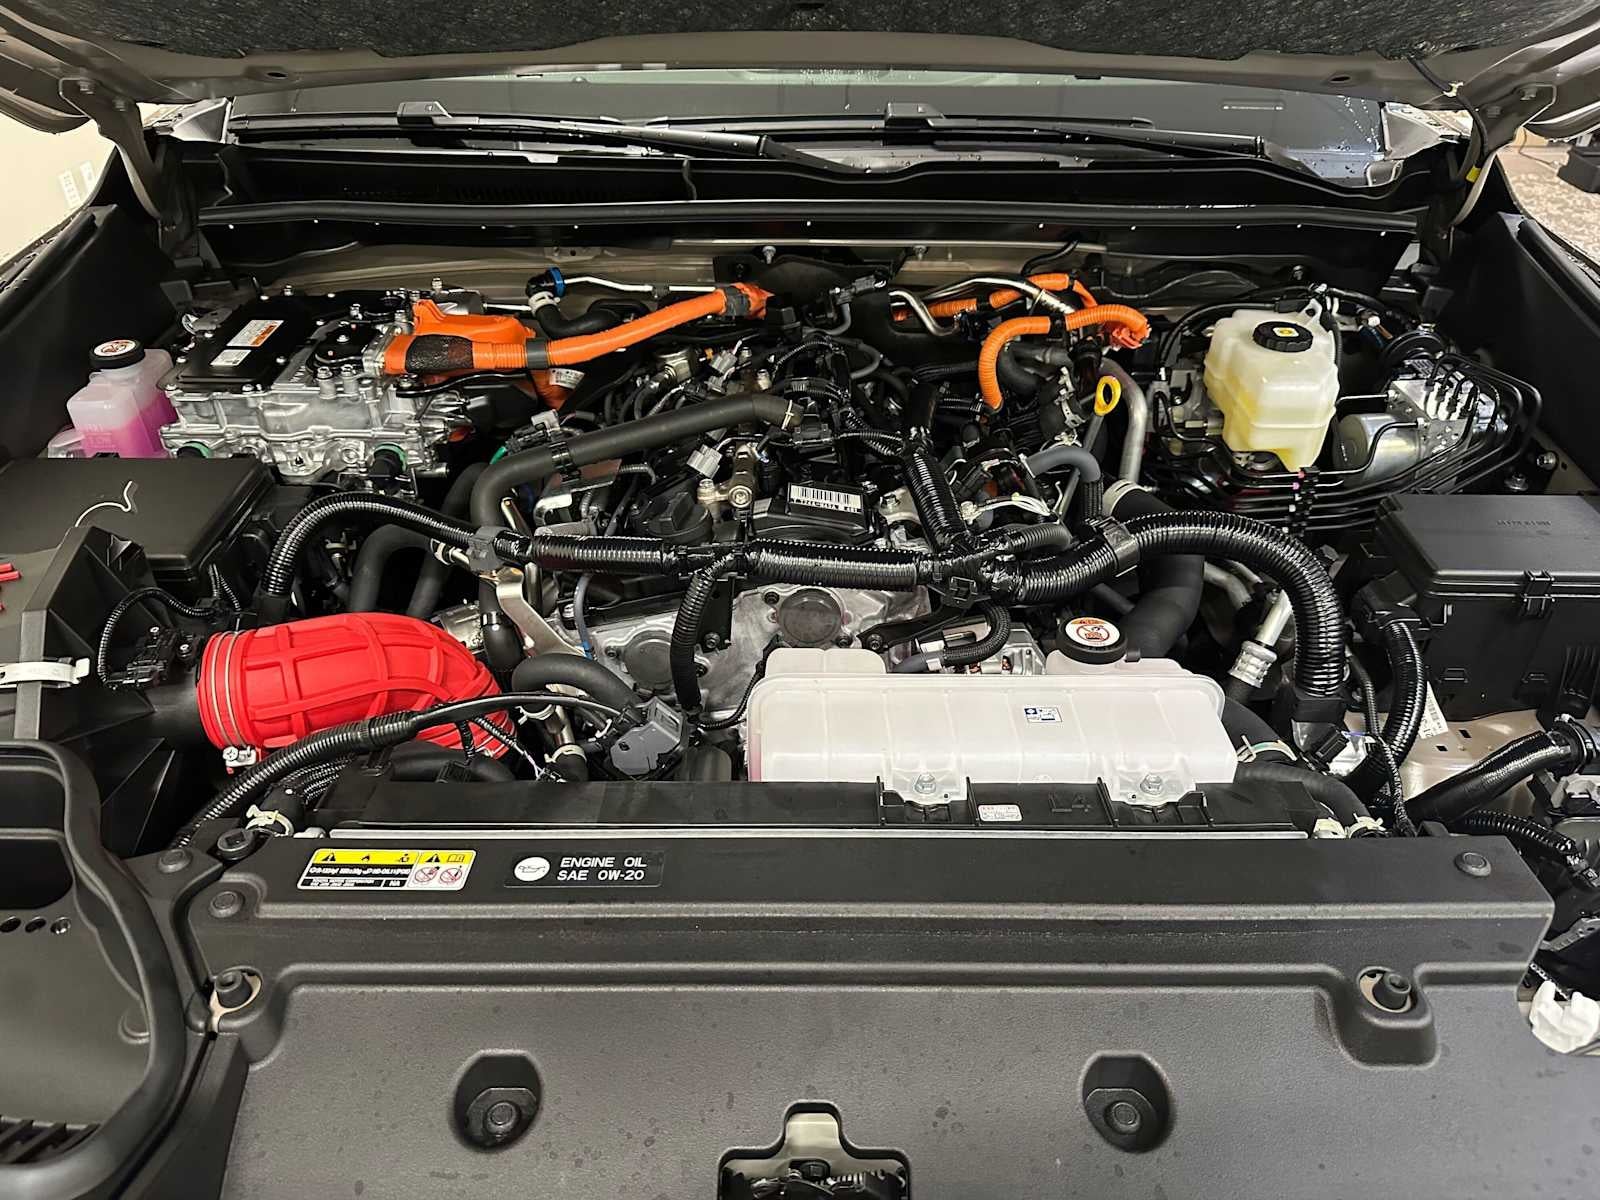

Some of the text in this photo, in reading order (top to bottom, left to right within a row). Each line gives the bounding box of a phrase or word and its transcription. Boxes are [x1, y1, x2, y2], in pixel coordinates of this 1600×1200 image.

[560, 857, 647, 868] ENGINE OIL
[557, 870, 645, 881] SAE 0W-20
